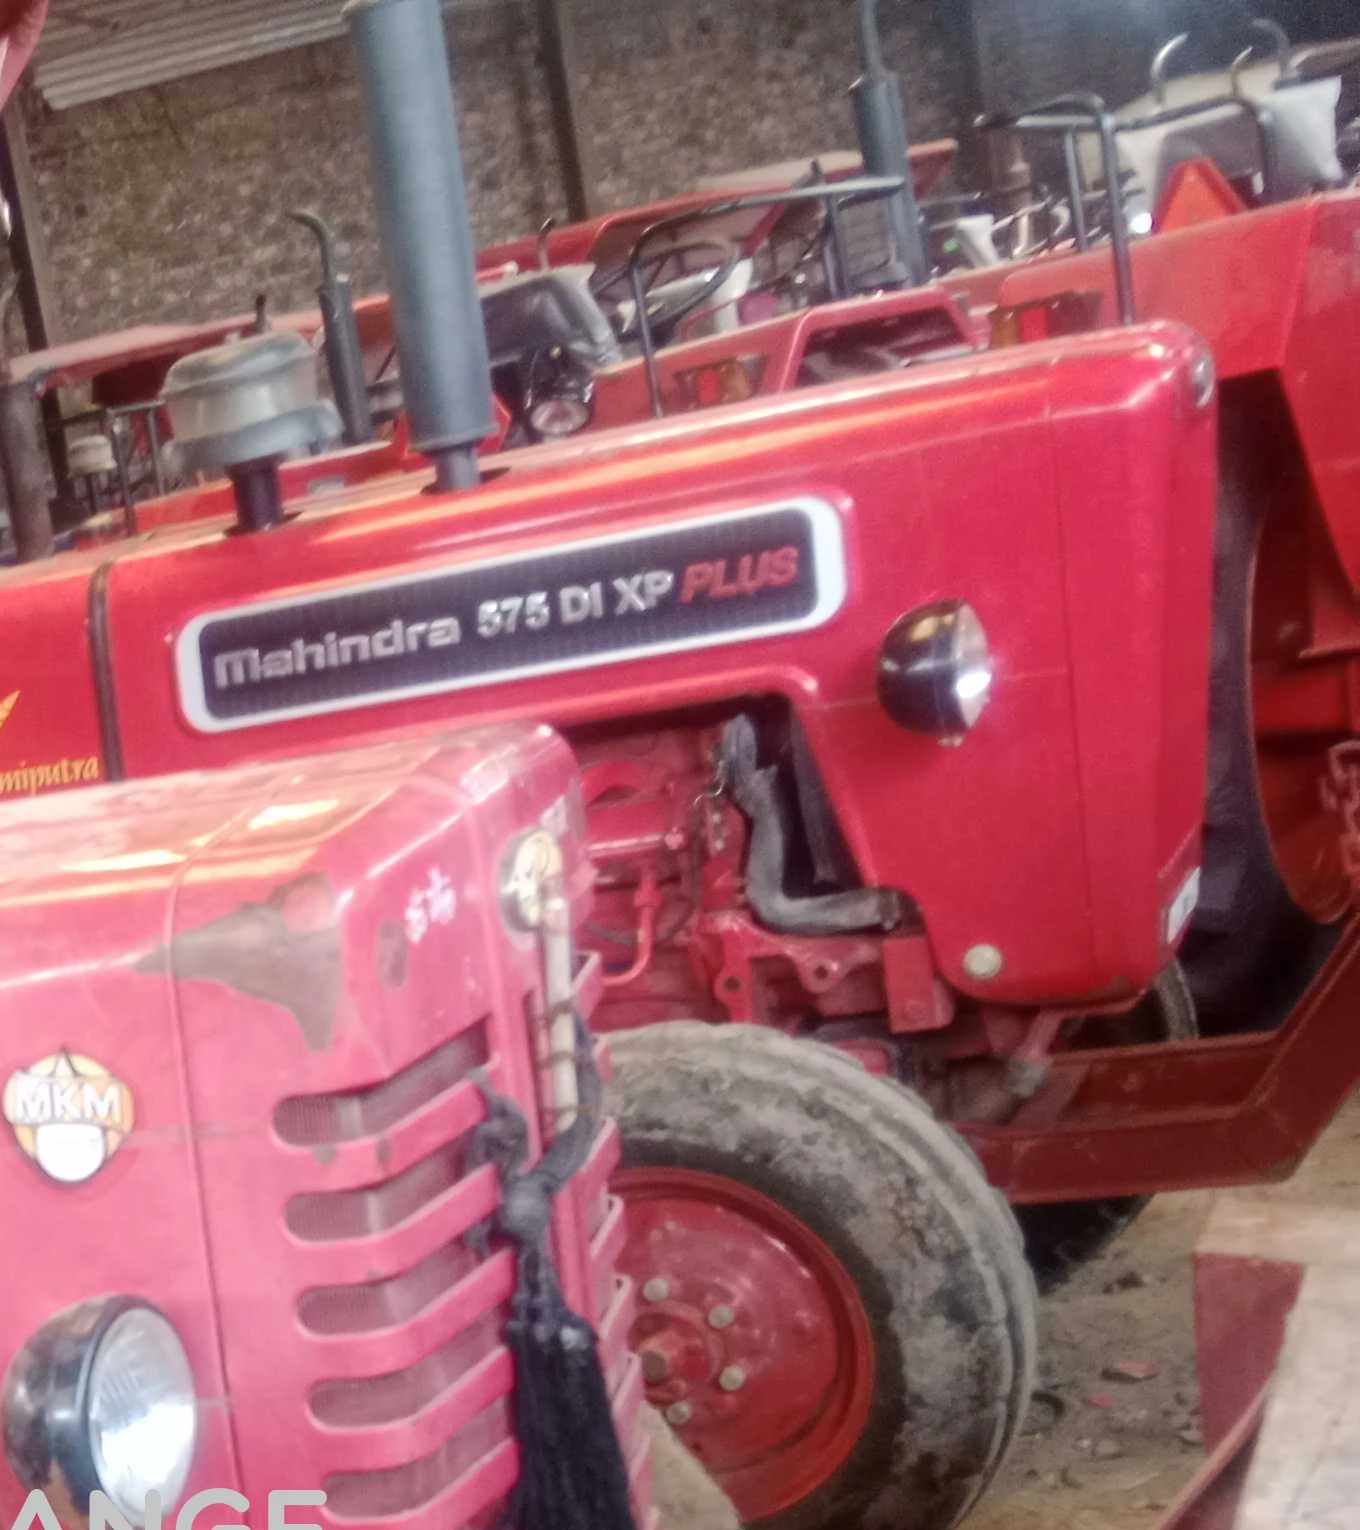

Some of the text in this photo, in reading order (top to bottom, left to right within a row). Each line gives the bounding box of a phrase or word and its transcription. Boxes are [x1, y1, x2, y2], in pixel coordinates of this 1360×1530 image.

[214, 545, 800, 689] Mahindra 575 DI XP PLUS
